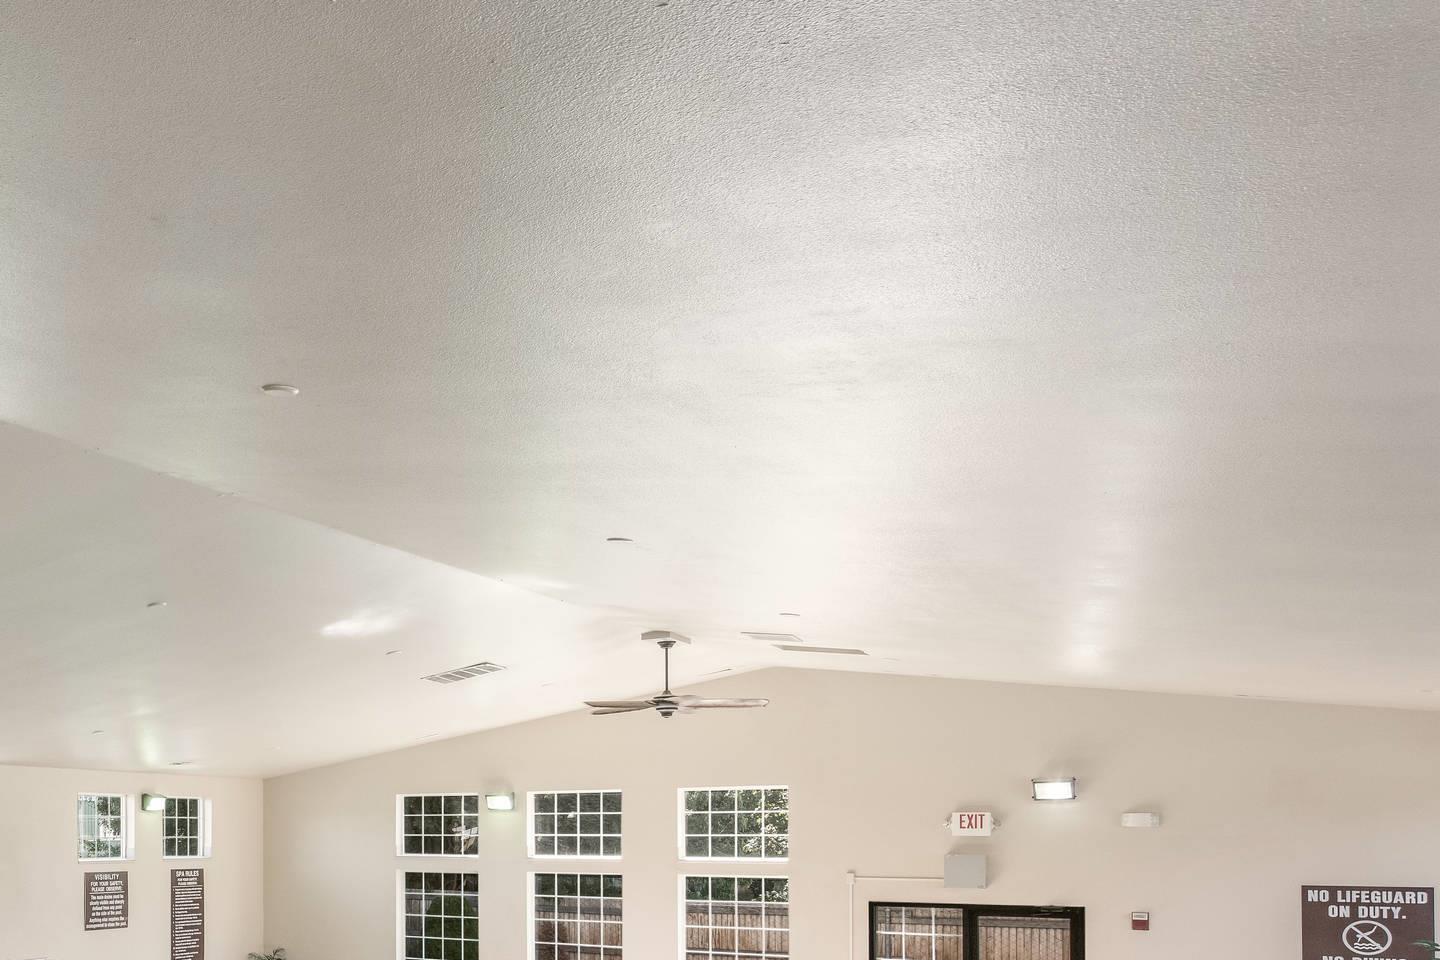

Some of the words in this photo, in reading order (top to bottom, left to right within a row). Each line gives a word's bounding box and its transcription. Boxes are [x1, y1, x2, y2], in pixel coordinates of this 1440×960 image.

[960, 814, 985, 829] EXIT
[1307, 889, 1329, 902] NO
[1337, 890, 1428, 904] LIFEGUARD
[1328, 905, 1350, 918] ON
[1358, 906, 1406, 919] DUTY.
